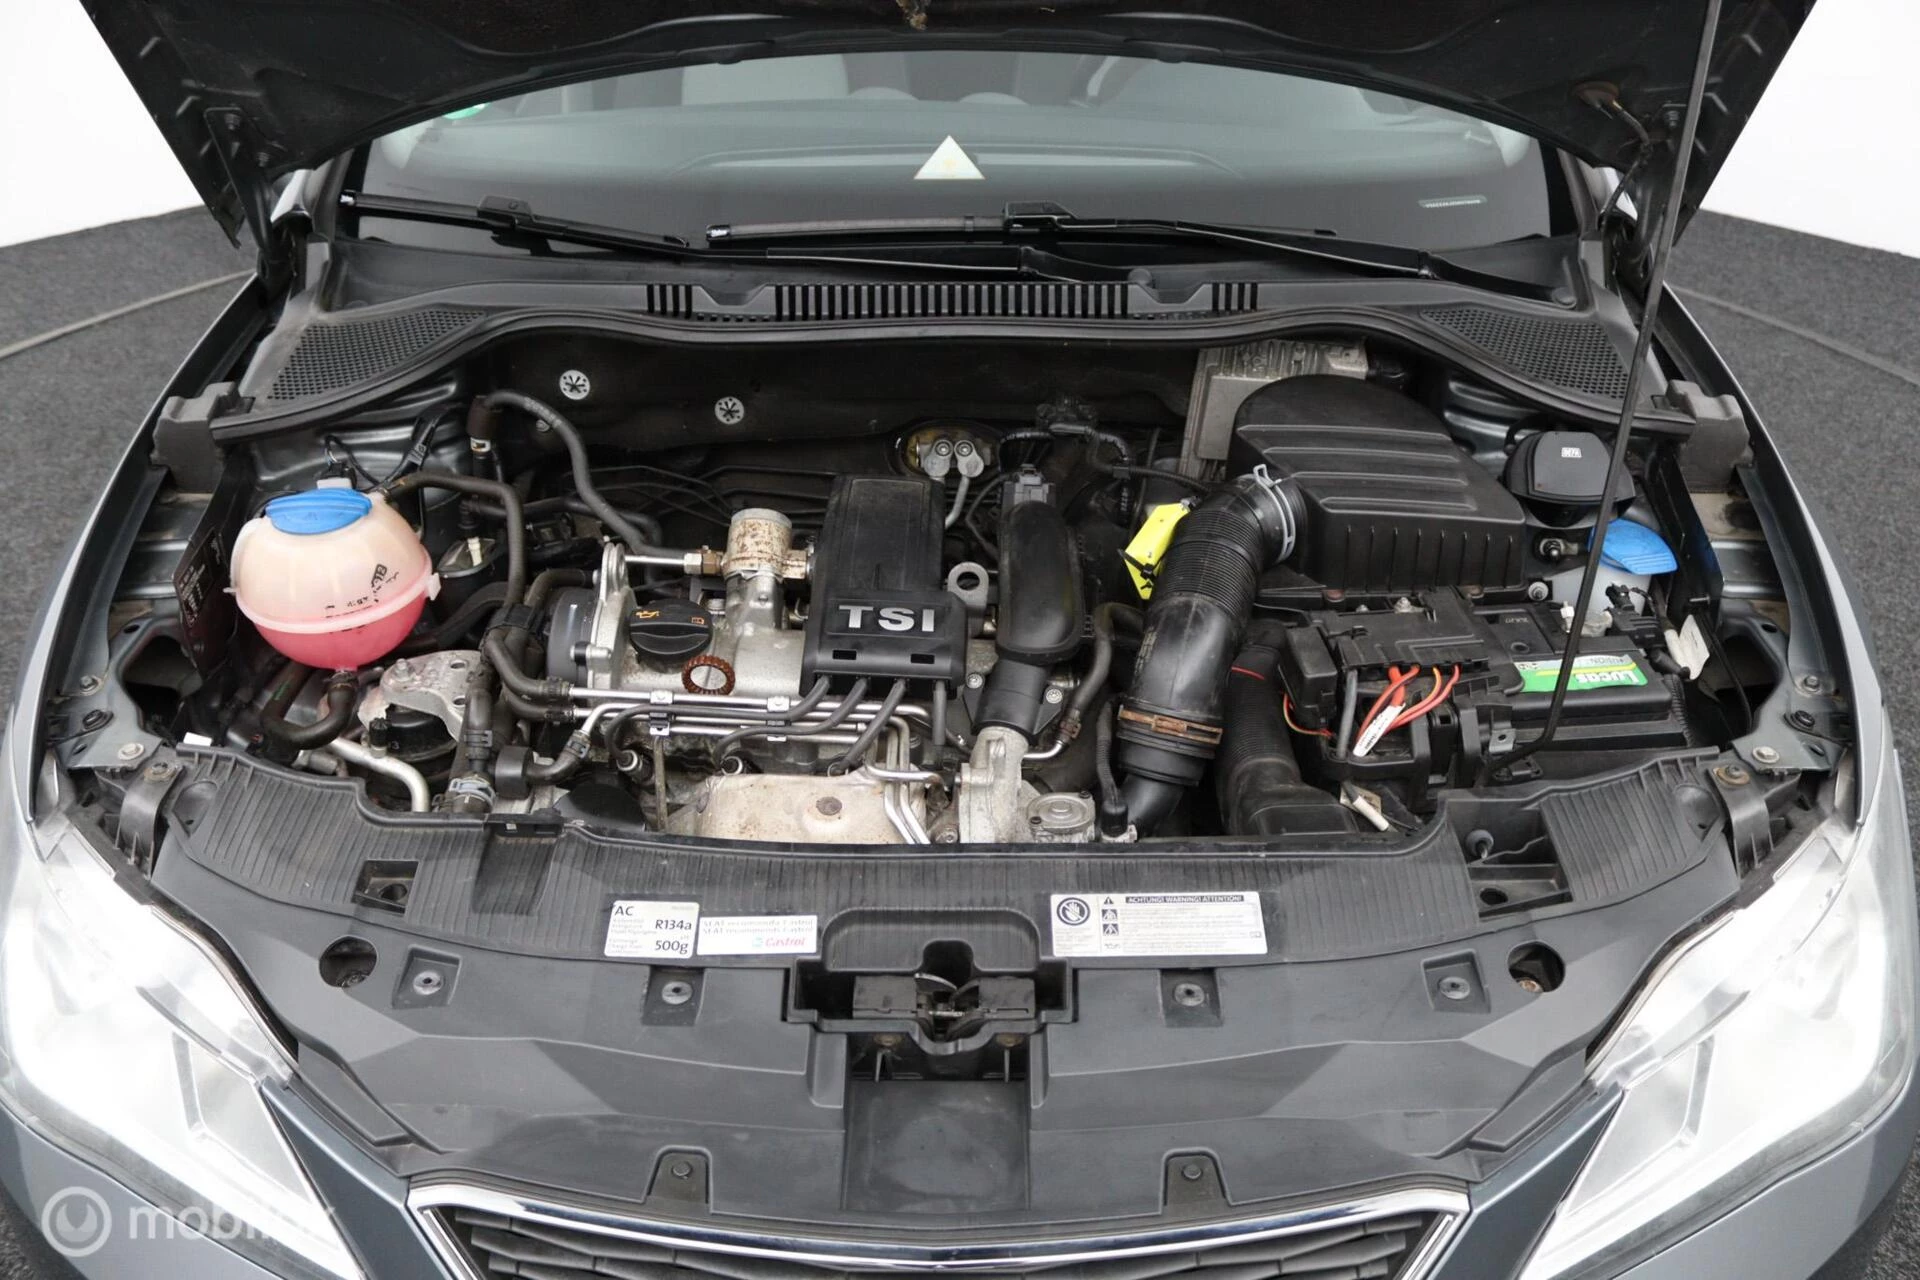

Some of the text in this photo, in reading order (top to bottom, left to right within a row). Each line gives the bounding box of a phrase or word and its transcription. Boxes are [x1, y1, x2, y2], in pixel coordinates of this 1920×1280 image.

[839, 605, 935, 632] TSI
[614, 906, 634, 916] AC
[655, 919, 692, 930] R134a
[654, 940, 689, 955] 500g
[766, 937, 806, 947] Castrol
